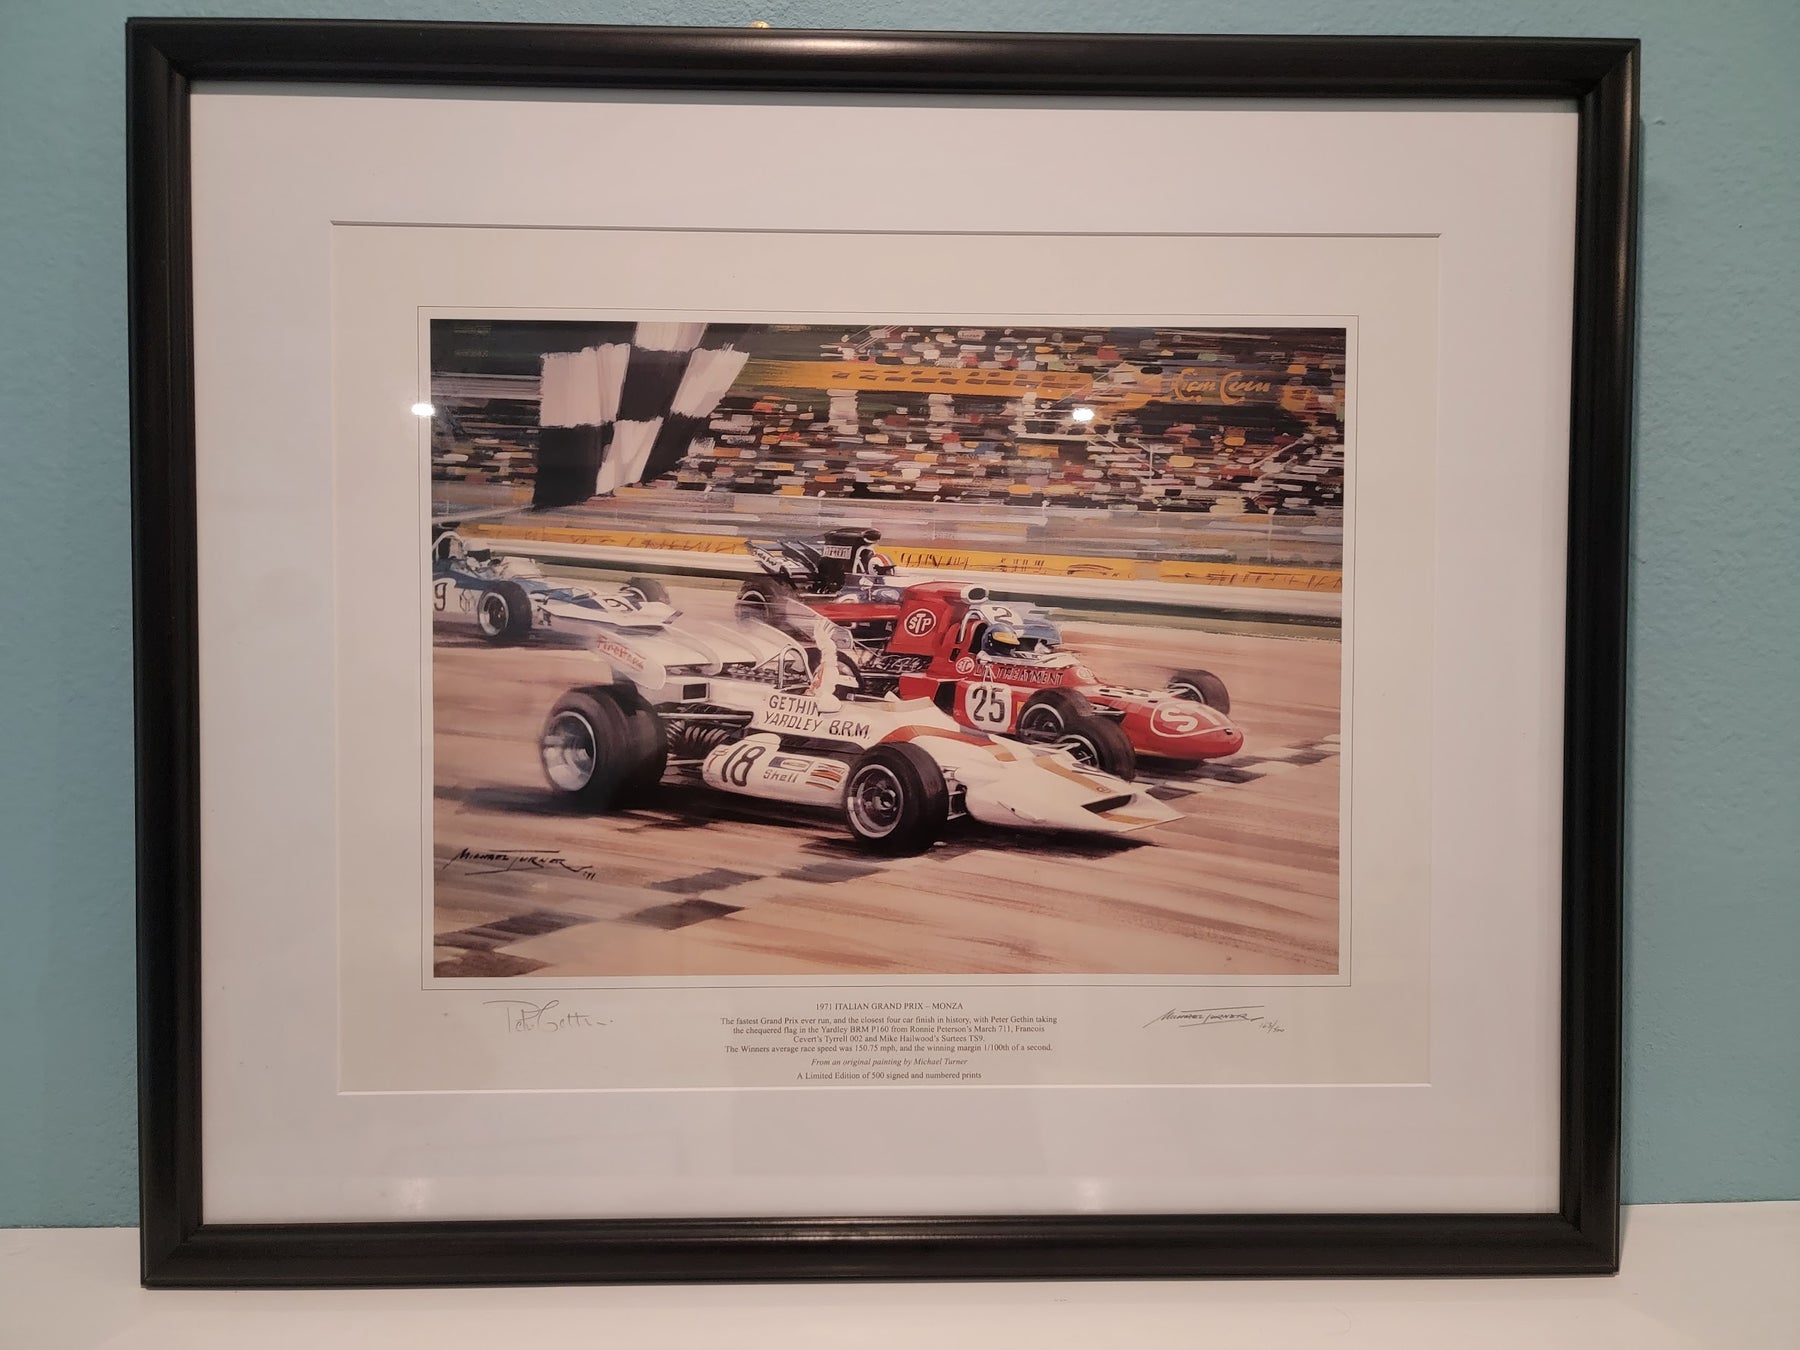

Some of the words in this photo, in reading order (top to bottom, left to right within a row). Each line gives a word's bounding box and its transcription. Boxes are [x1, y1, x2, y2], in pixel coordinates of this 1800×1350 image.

[908, 612, 933, 634] STP
[972, 686, 1006, 723] 25
[763, 710, 823, 732] YARDLEY
[721, 744, 767, 787] 18
[763, 769, 799, 784] Shell
[871, 1002, 901, 1010] GRAND
[904, 1002, 923, 1010] PRIX
[932, 1002, 963, 1010] MONZA
[720, 1017, 735, 1025] The
[736, 1017, 758, 1025] fastest
[760, 1017, 782, 1025] Grand
[887, 1016, 901, 1024] four
[915, 1016, 935, 1024] finish
[937, 1016, 944, 1024] in
[946, 1016, 971, 1026] history,
[1035, 1016, 1057, 1025] taking
[733, 1026, 744, 1034] the
[746, 1026, 782, 1036] chequered
[784, 1026, 798, 1036] flag
[800, 1026, 806, 1034] in
[821, 1026, 847, 1035] Yardley
[910, 1025, 934, 1033] Ronnie
[974, 1025, 996, 1033] March
[998, 1025, 1013, 1033] 711,
[825, 1035, 848, 1045] Tyrrell
[968, 1034, 986, 1042] TS9.
[817, 1044, 837, 1054] speed
[854, 1044, 878, 1052] 150.75
[880, 1044, 898, 1053] mph,
[926, 1044, 955, 1053] winning
[957, 1044, 982, 1053] margin
[984, 1043, 1009, 1051] 1/100th
[1011, 1043, 1020, 1051] of
[1026, 1043, 1053, 1051] second.
[811, 1058, 830, 1066] From
[843, 1058, 871, 1067] original
[872, 1058, 901, 1067] painting
[903, 1058, 912, 1067] by
[913, 1057, 942, 1065] Michael
[944, 1057, 968, 1065] Turner
[886, 1071, 909, 1081] signed
[910, 1071, 924, 1079] and
[925, 1071, 960, 1079] numbered
[962, 1071, 982, 1081] prints
